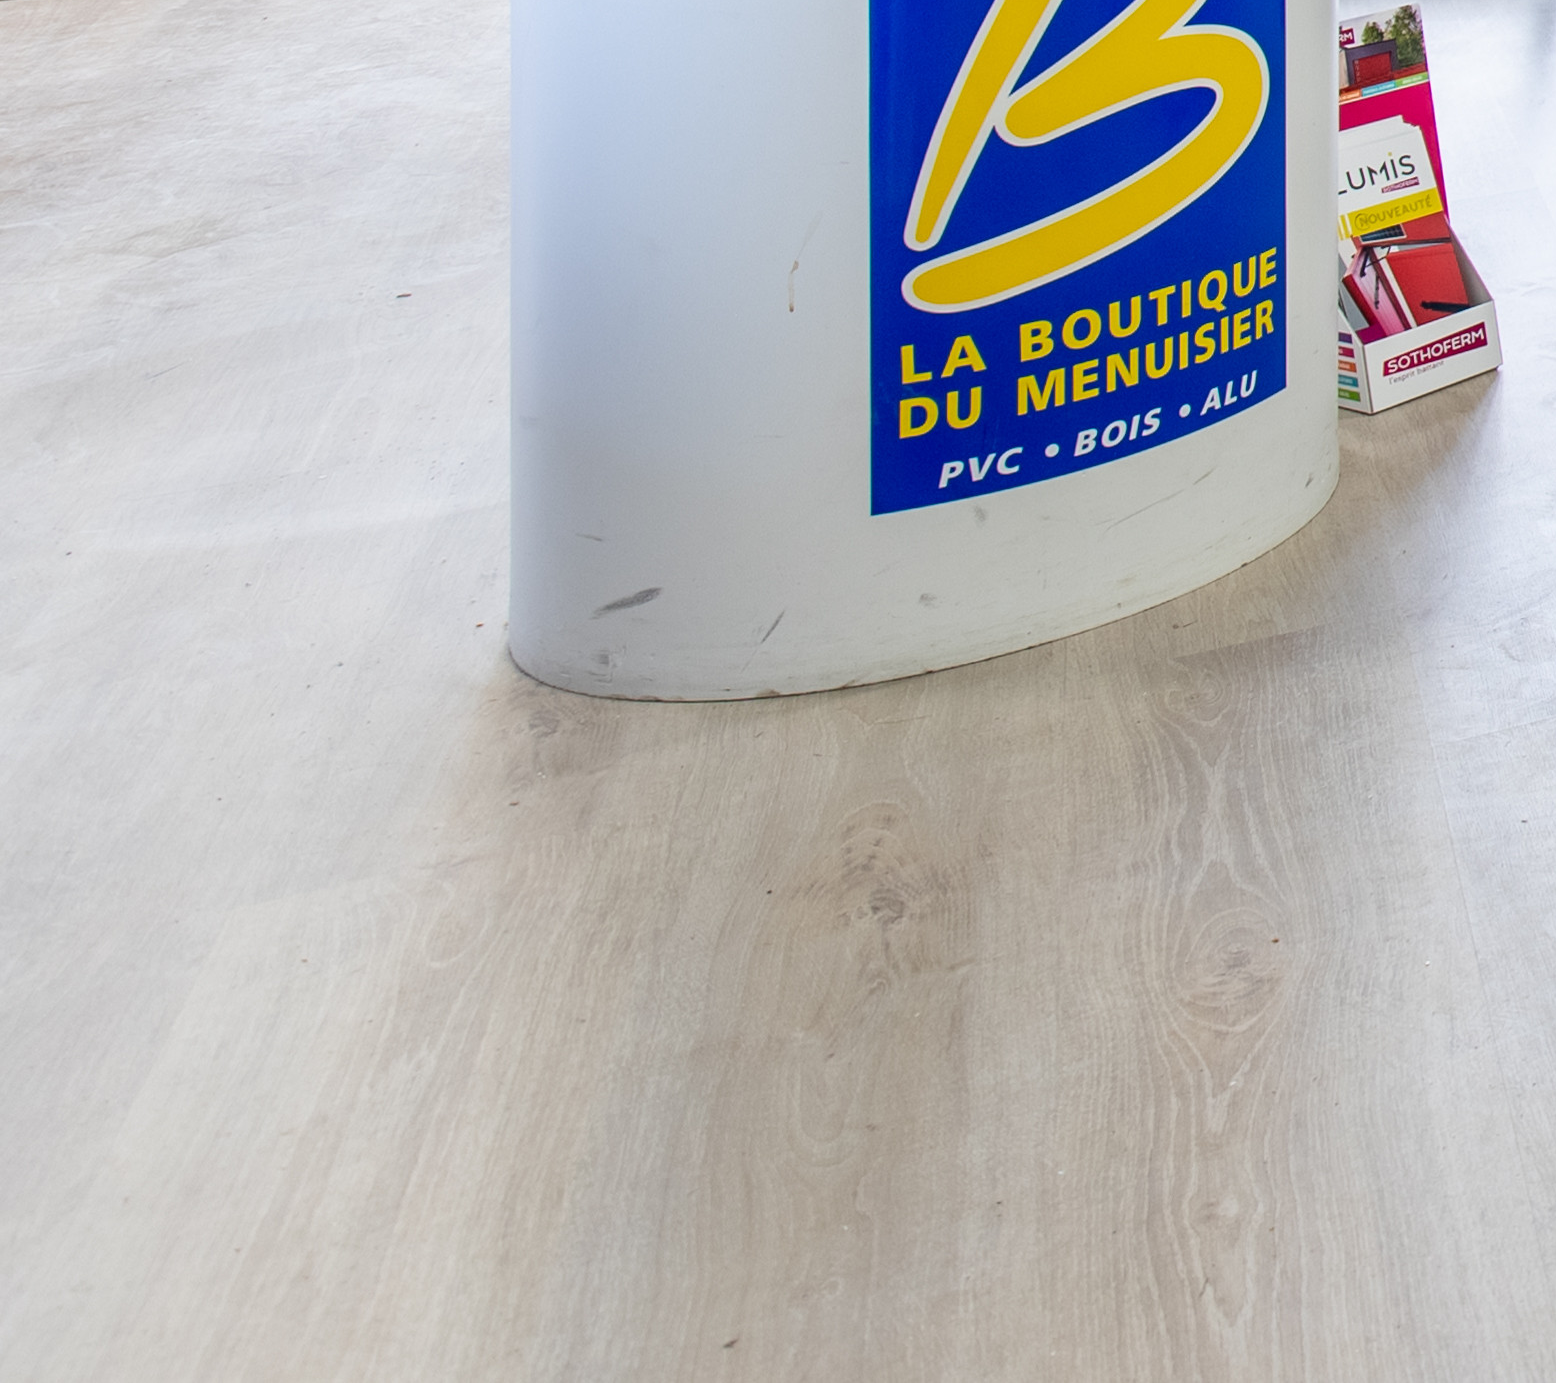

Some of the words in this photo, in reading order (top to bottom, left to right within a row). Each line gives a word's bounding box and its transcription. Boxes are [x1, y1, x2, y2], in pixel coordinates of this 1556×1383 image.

[1338, 152, 1416, 195] UMIS
[1358, 196, 1433, 227] NOUVEAUTÉ
[900, 334, 988, 385] LA
[1019, 247, 1278, 362] BOUTIQUE
[1386, 327, 1486, 374] SOTHOFERM
[899, 386, 983, 439] DU
[1017, 299, 1275, 416] MENUISIER
[938, 446, 1024, 489] PVC
[1074, 407, 1163, 457] BOIS
[1200, 369, 1259, 416] ALU
